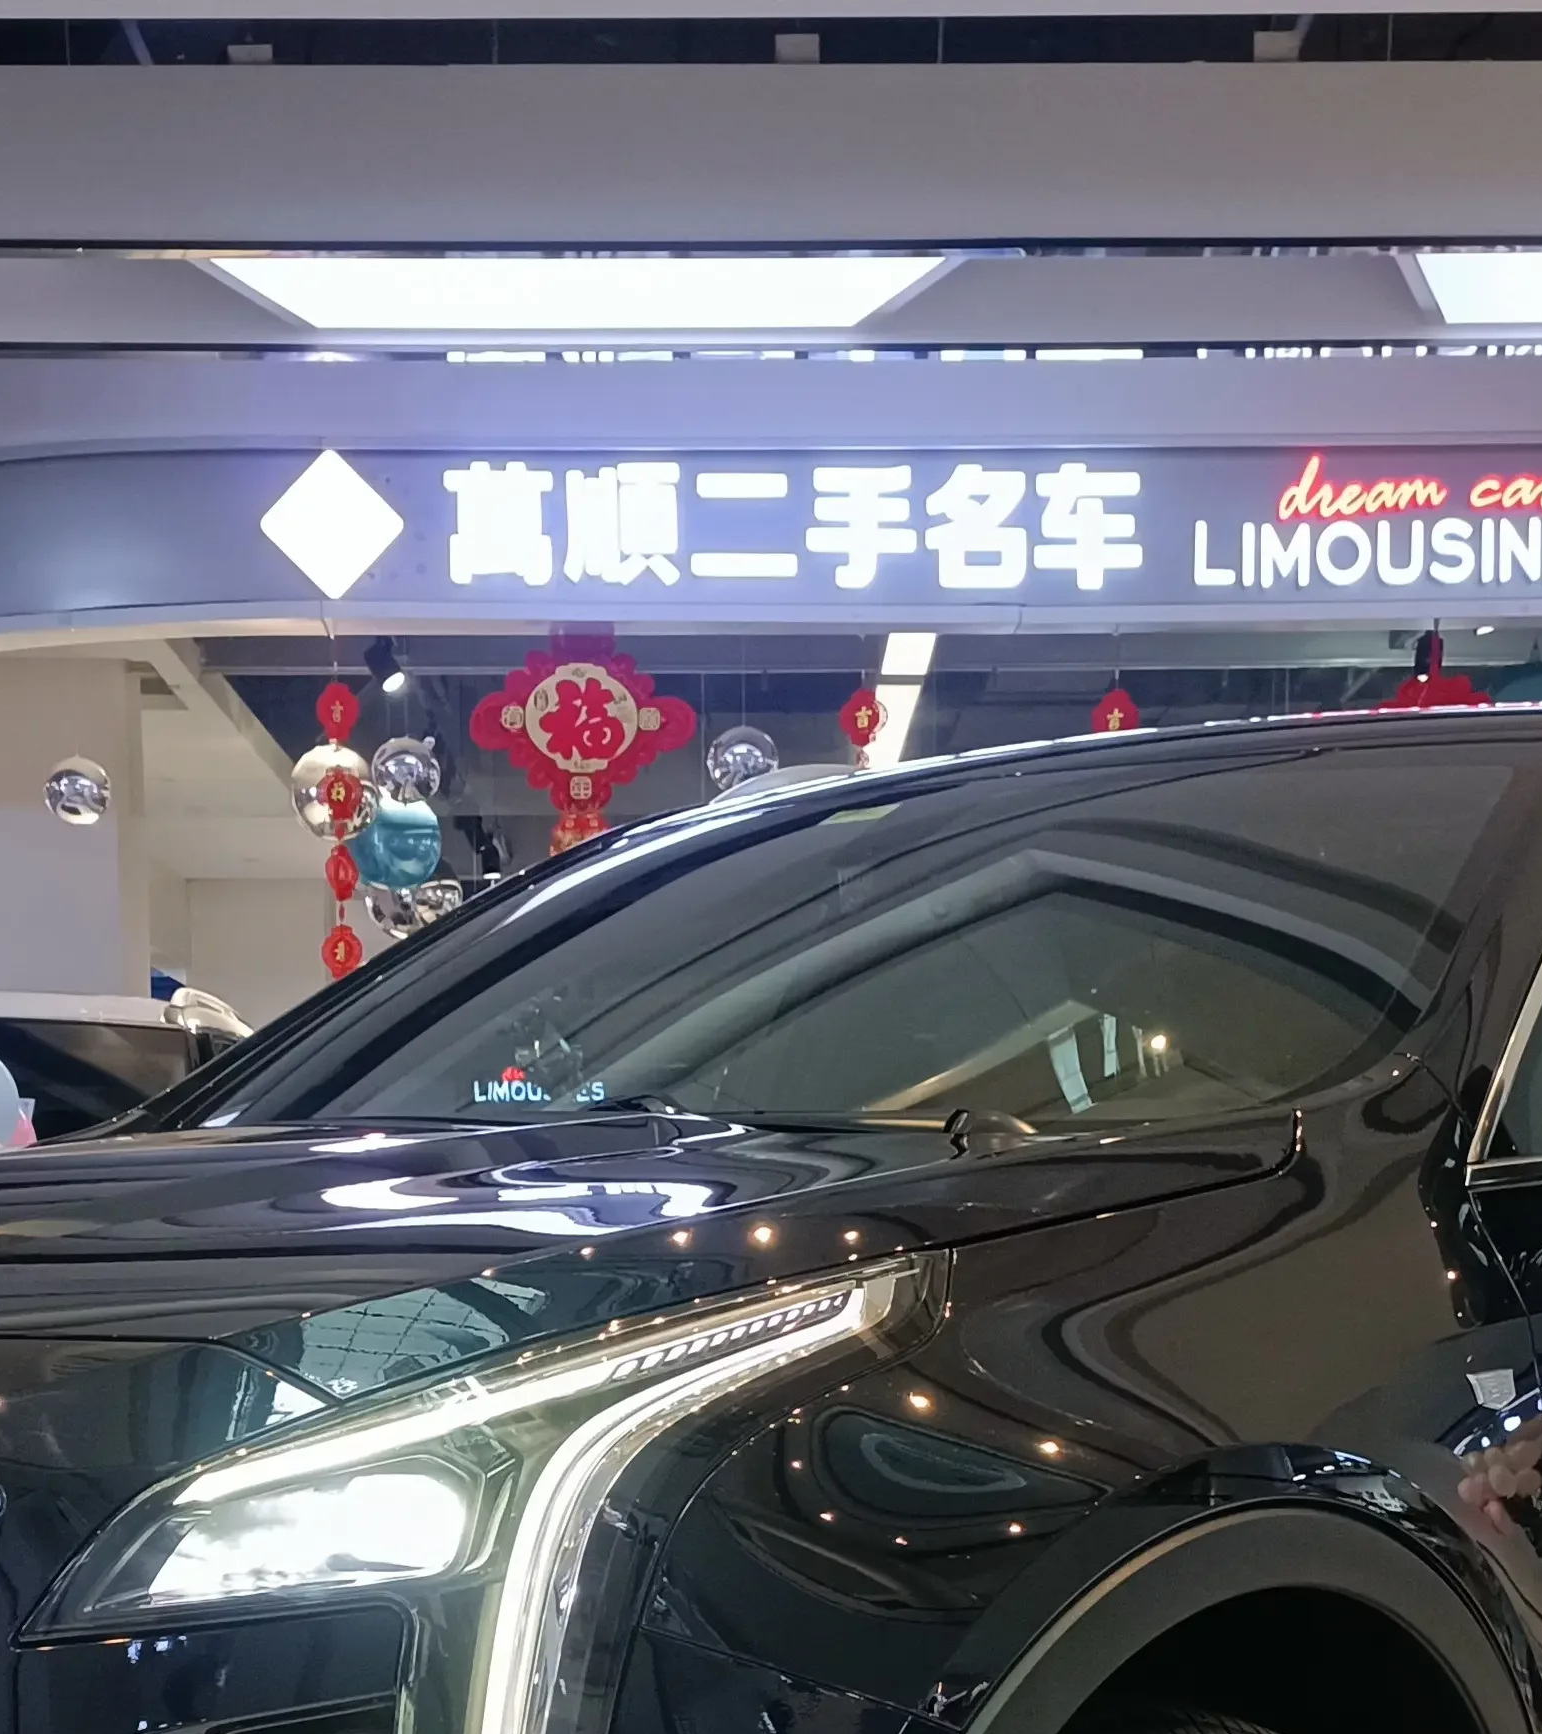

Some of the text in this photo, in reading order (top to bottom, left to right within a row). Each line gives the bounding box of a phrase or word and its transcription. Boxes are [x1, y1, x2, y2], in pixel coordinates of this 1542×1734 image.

[1278, 453, 1448, 521] dream
[539, 677, 626, 760] 福
[473, 1079, 605, 1103] LIMOUES
